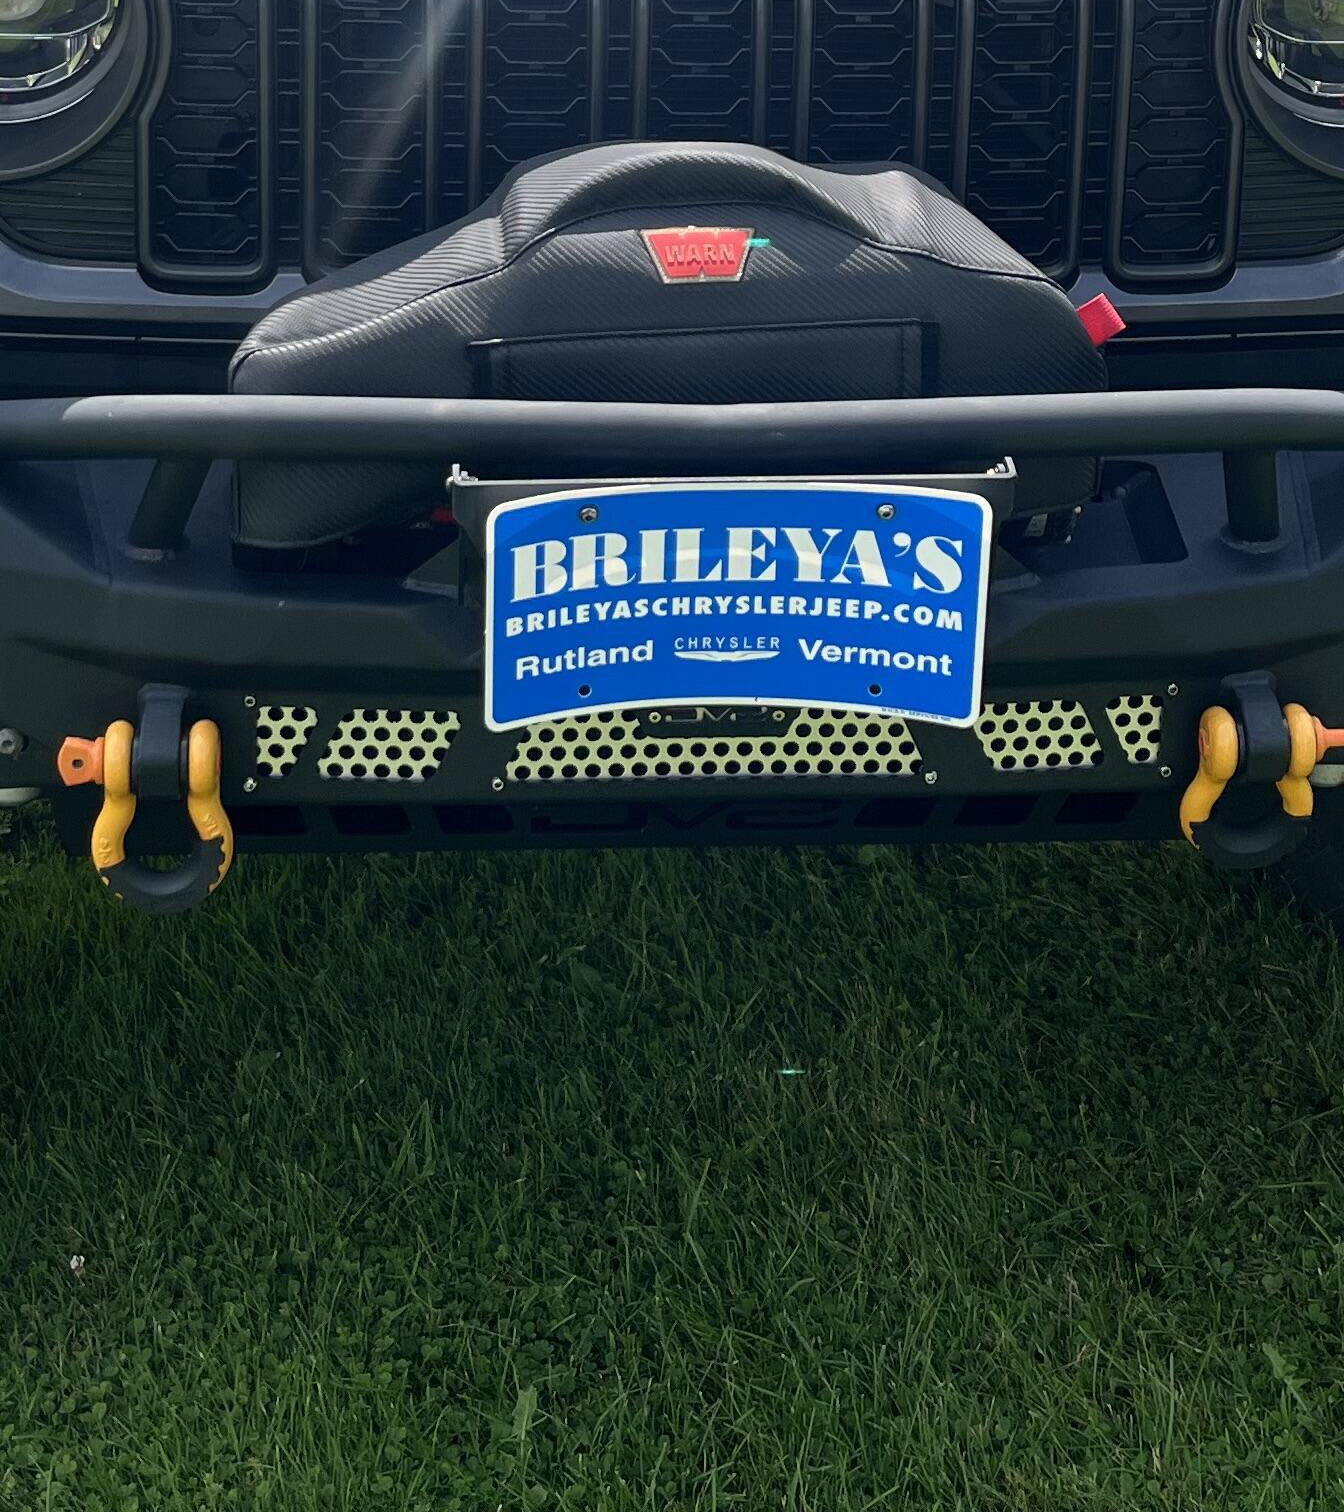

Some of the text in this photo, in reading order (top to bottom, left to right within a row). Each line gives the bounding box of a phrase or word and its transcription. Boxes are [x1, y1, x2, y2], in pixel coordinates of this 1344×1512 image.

[664, 243, 736, 267] WARN
[510, 527, 963, 604] BRILEYA'S
[506, 595, 963, 637] BRILEYASCHRYSLERJEEP.COM
[515, 636, 953, 681] Rutland CHRYSLER Vermont
